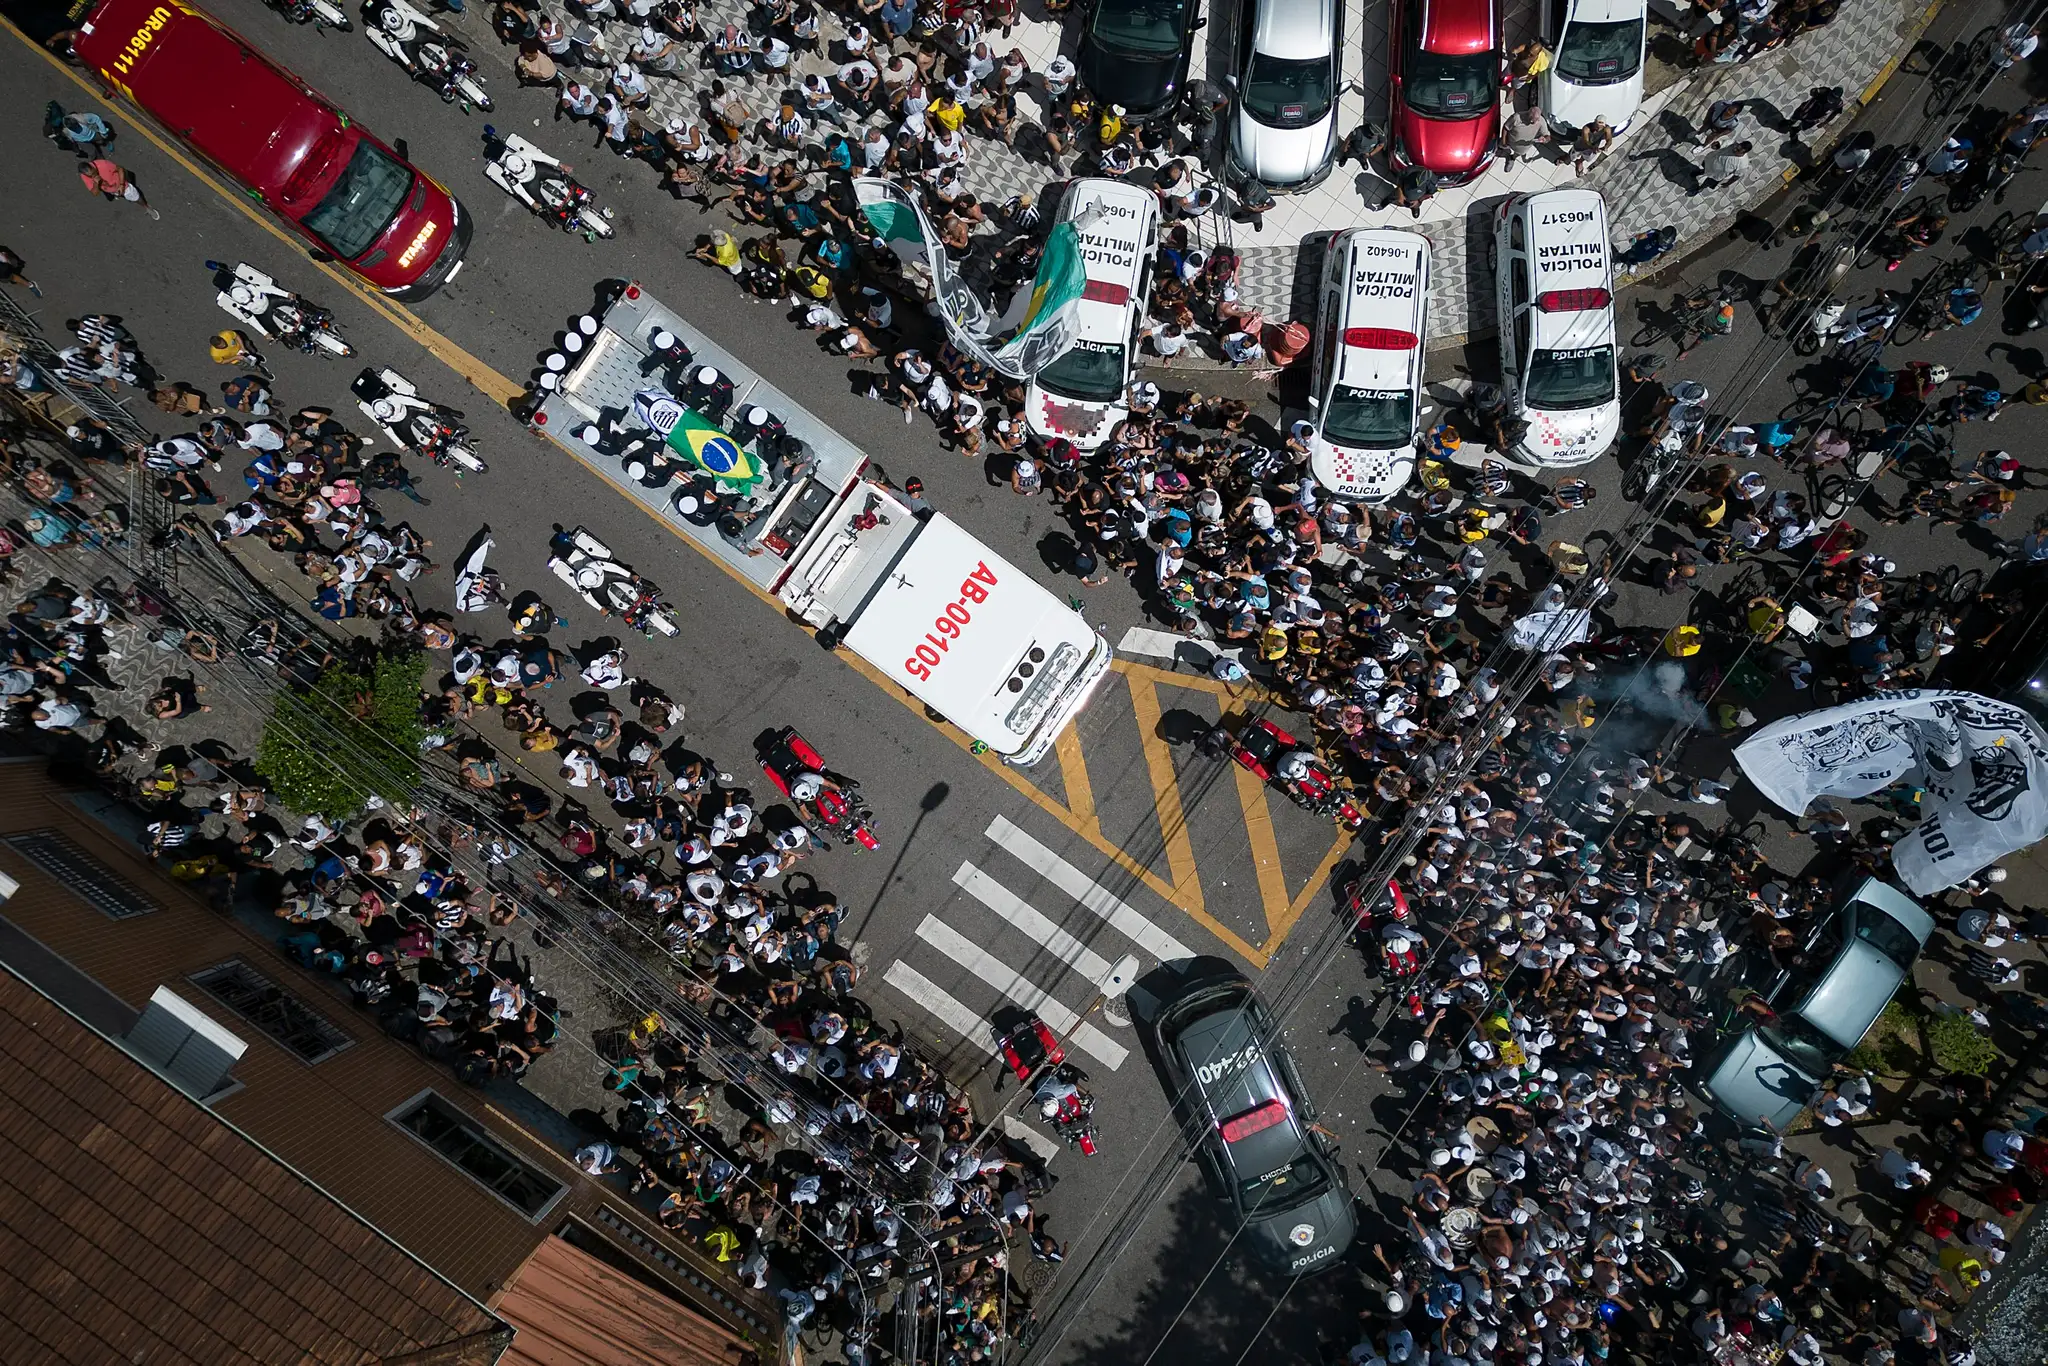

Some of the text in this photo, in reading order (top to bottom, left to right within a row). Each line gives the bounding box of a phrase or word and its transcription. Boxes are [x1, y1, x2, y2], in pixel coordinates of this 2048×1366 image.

[113, 6, 172, 74] UR-06111
[1542, 210, 1594, 225] I-06317
[1080, 248, 1133, 268] POLÍCI
[1367, 246, 1409, 259] I-06402
[1538, 243, 1601, 258] MILITAR
[1540, 257, 1603, 273] POLÍCIA
[1356, 271, 1415, 285] MILITAR
[1356, 284, 1413, 300] POLÍCIA
[1073, 339, 1108, 354] OLÍCIA
[1349, 388, 1398, 400] POLÍCIA
[904, 560, 998, 682] AB-06105
[1919, 813, 1955, 865] HO!
